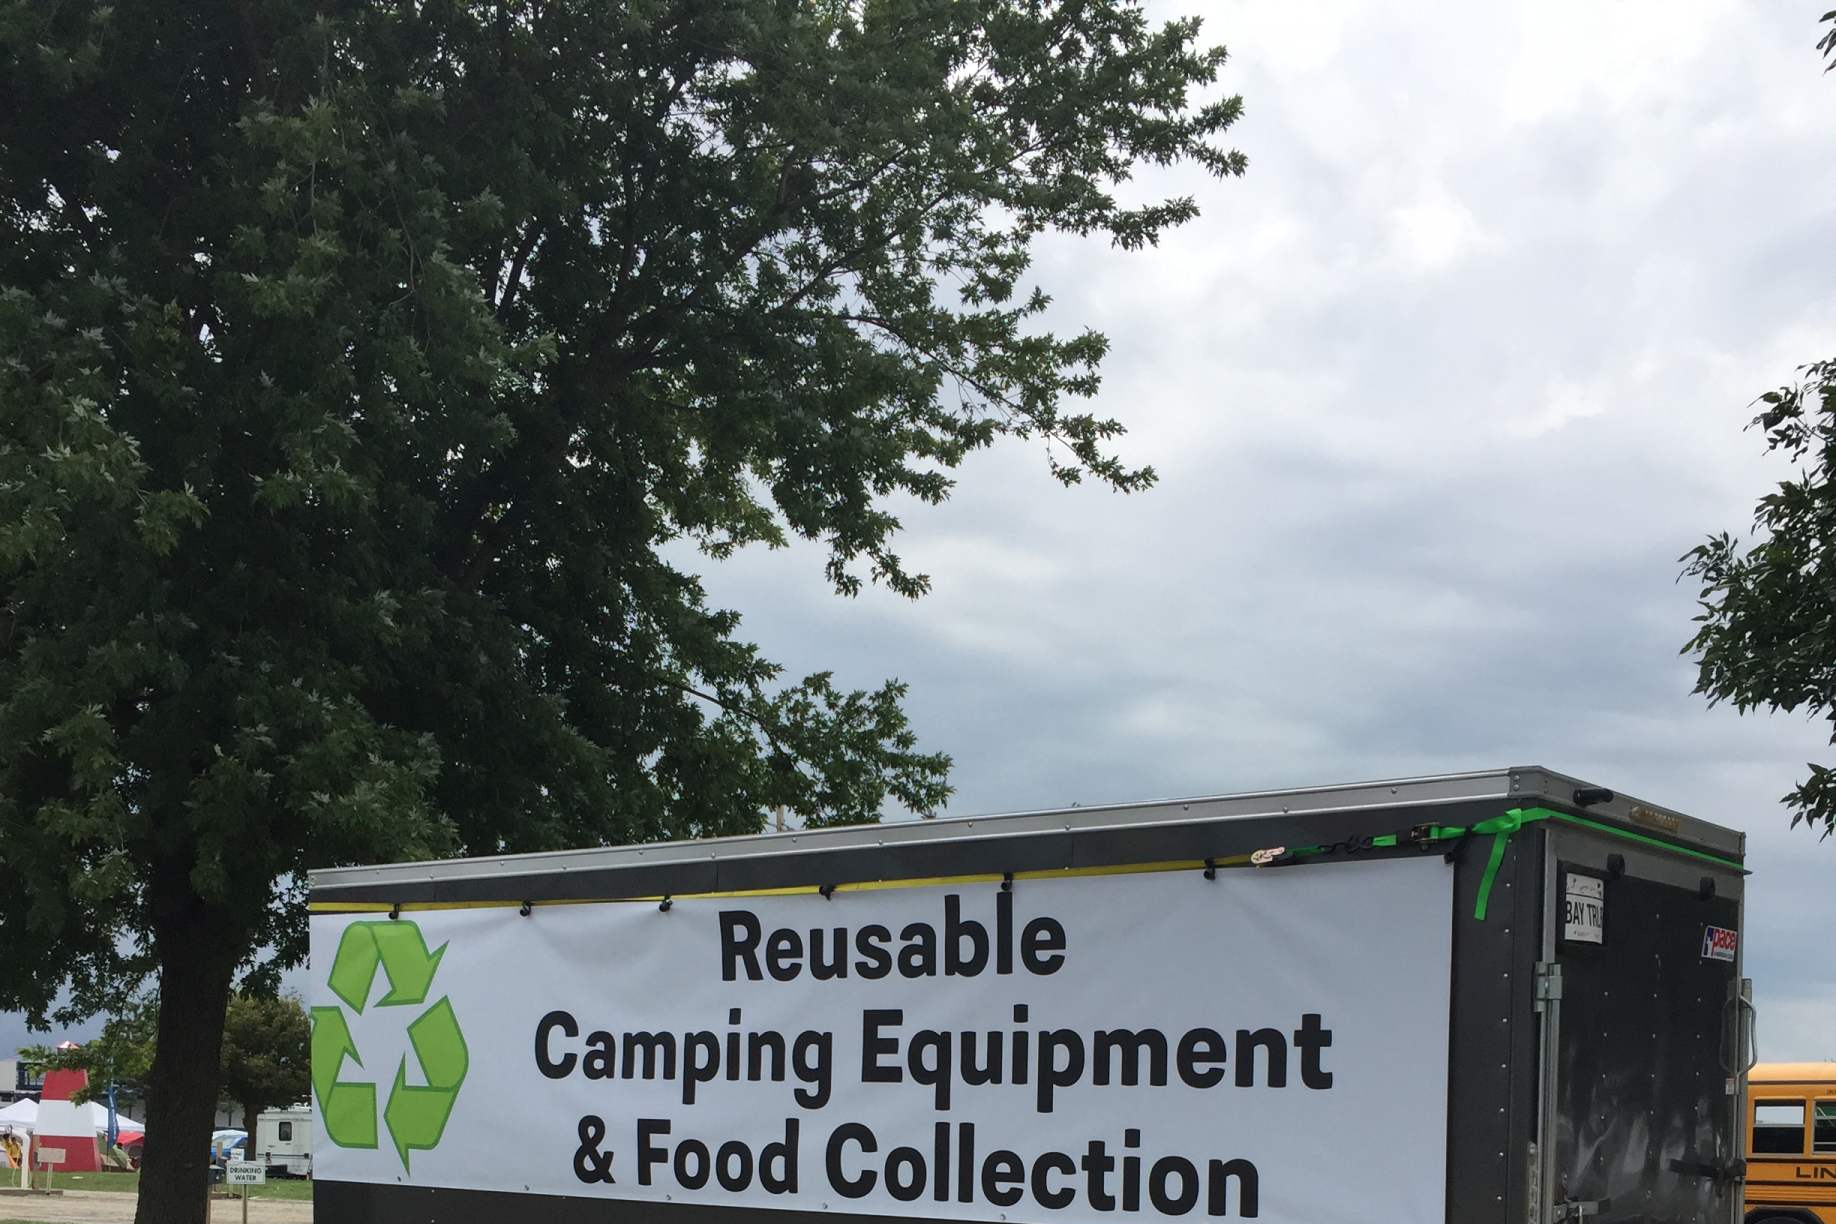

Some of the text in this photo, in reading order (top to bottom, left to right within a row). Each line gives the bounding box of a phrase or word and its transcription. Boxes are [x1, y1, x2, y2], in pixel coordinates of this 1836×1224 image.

[719, 892, 1067, 982] Reusable
[1565, 900, 1585, 925] BAY
[534, 1004, 1333, 1113] Camping Equipment
[573, 1115, 1260, 1218] & Food Collection
